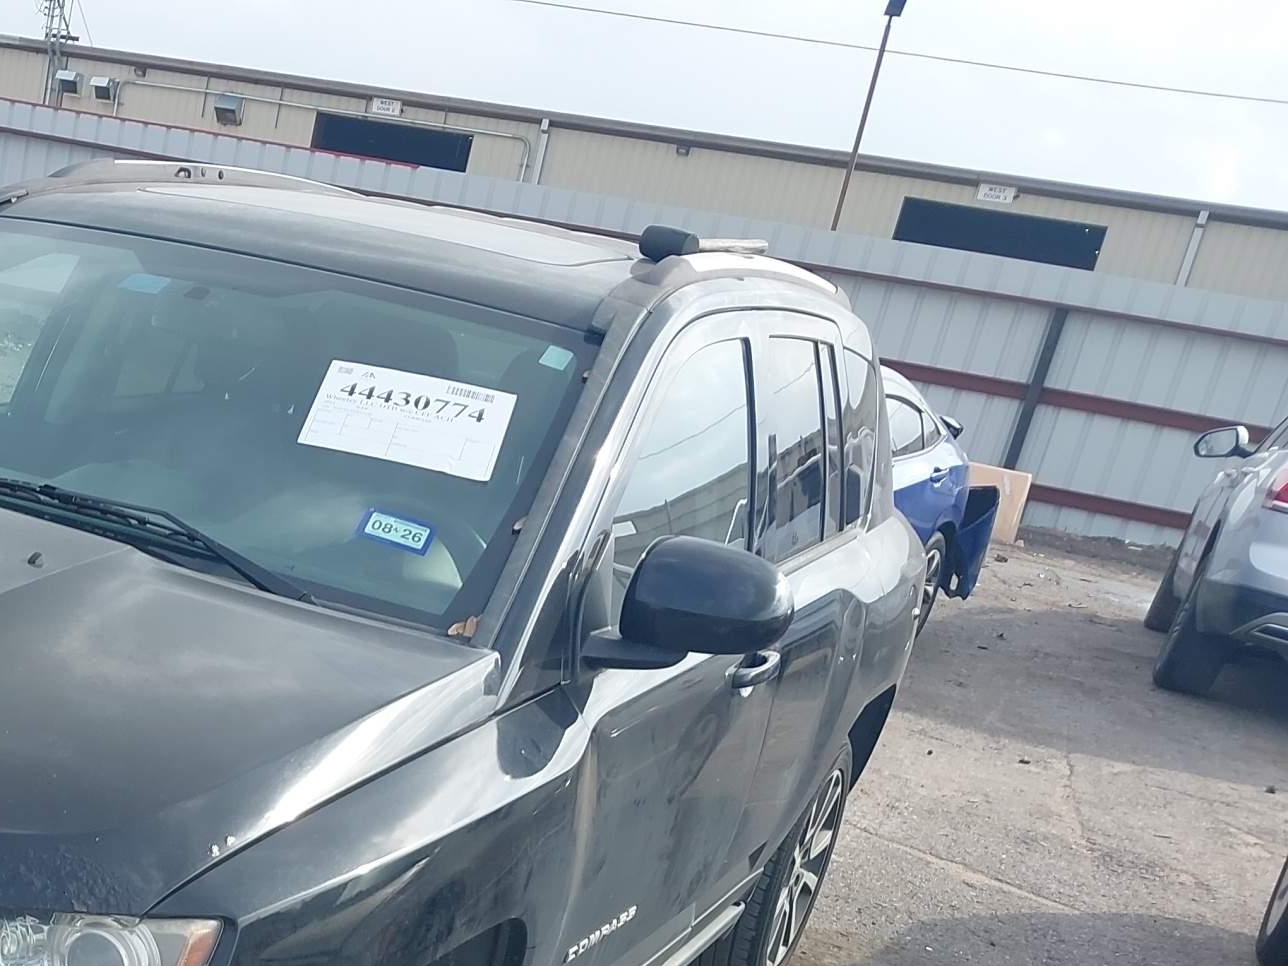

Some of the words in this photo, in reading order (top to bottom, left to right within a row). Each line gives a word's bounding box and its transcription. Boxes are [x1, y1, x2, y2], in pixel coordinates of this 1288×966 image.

[988, 186, 1007, 194] WEST
[340, 382, 486, 423] 44430774
[372, 519, 393, 534] 08
[400, 528, 423, 543] 26
[565, 905, 637, 963] COMPASS
